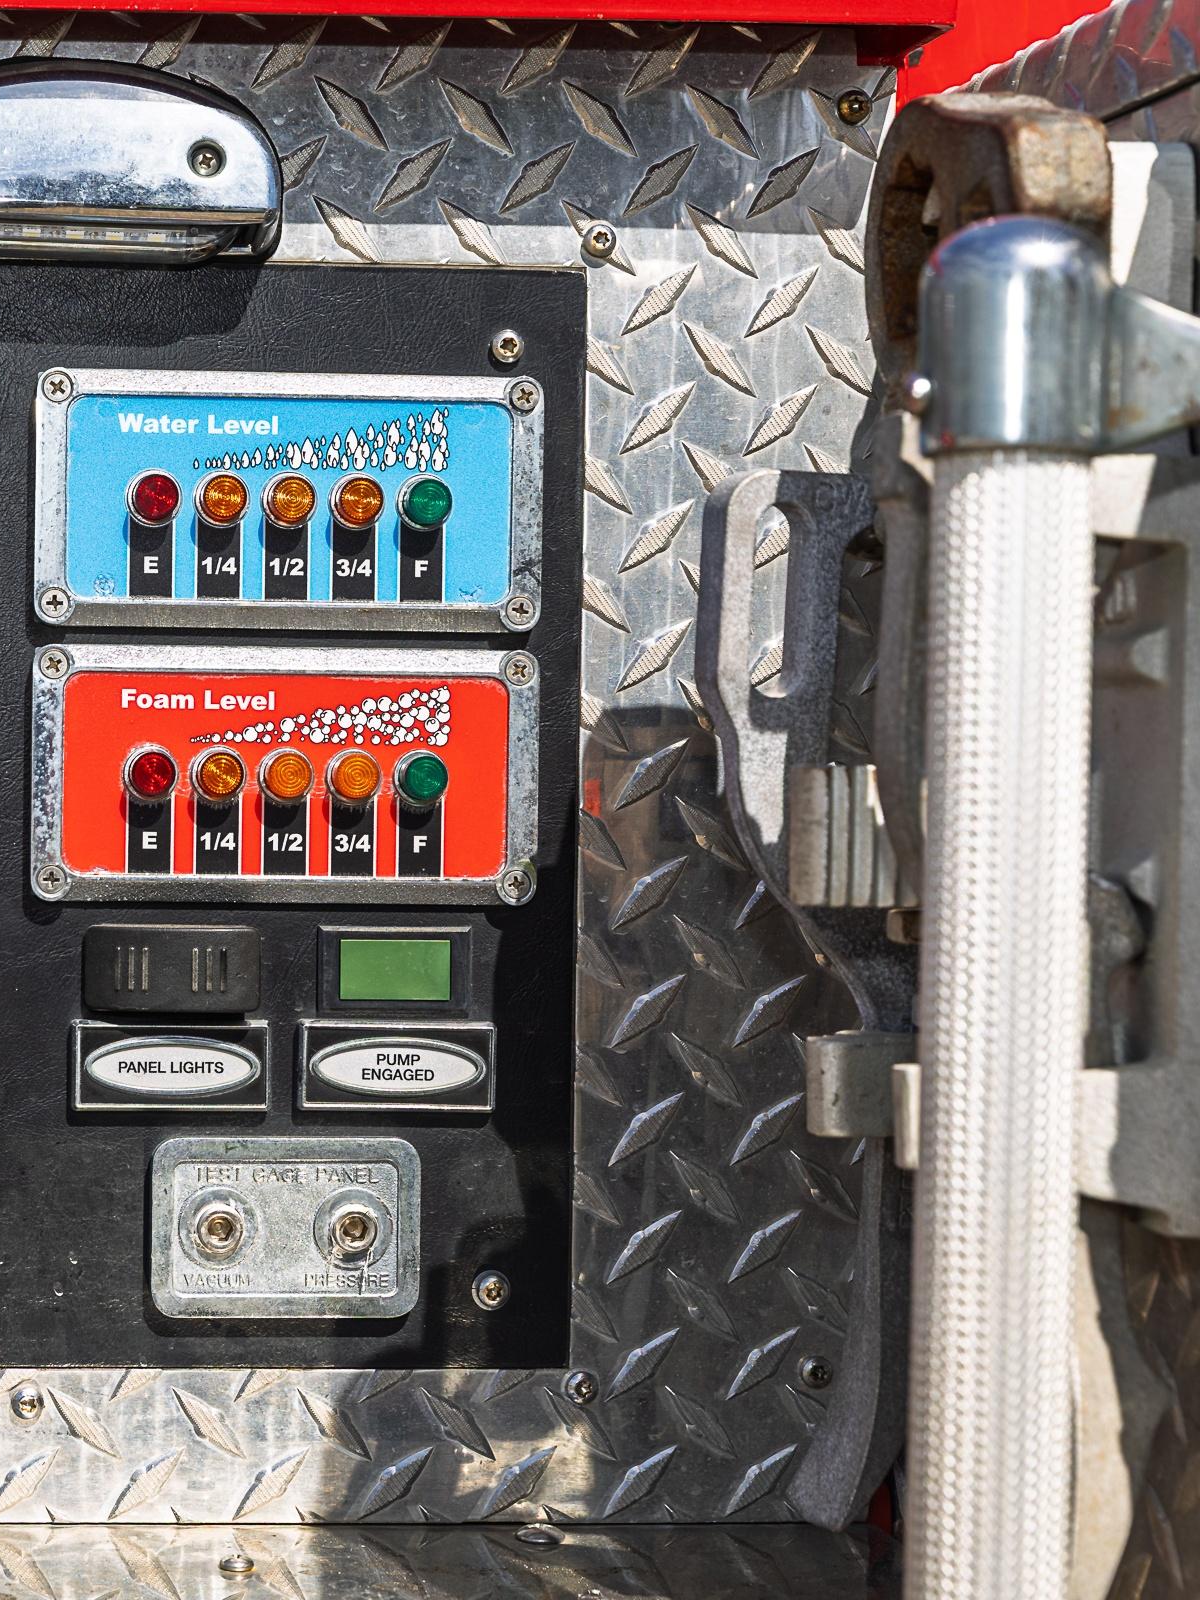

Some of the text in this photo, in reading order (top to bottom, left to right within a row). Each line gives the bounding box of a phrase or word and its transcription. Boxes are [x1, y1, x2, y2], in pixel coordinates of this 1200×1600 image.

[118, 413, 279, 436] Water Level
[143, 556, 428, 578] E 1/4 1/2 3/4 F
[121, 689, 276, 711] Foam Level
[142, 832, 427, 853] E 1/4 1/2 3/4 F
[376, 1053, 420, 1066] PUMP
[118, 1061, 224, 1075] PANEL LIGHTS
[361, 1068, 435, 1082] ENGAGED
[194, 1166, 380, 1184] TEST GAGE PANEL
[184, 1273, 250, 1287] VACUUM
[304, 1273, 389, 1288] PRESSRE
